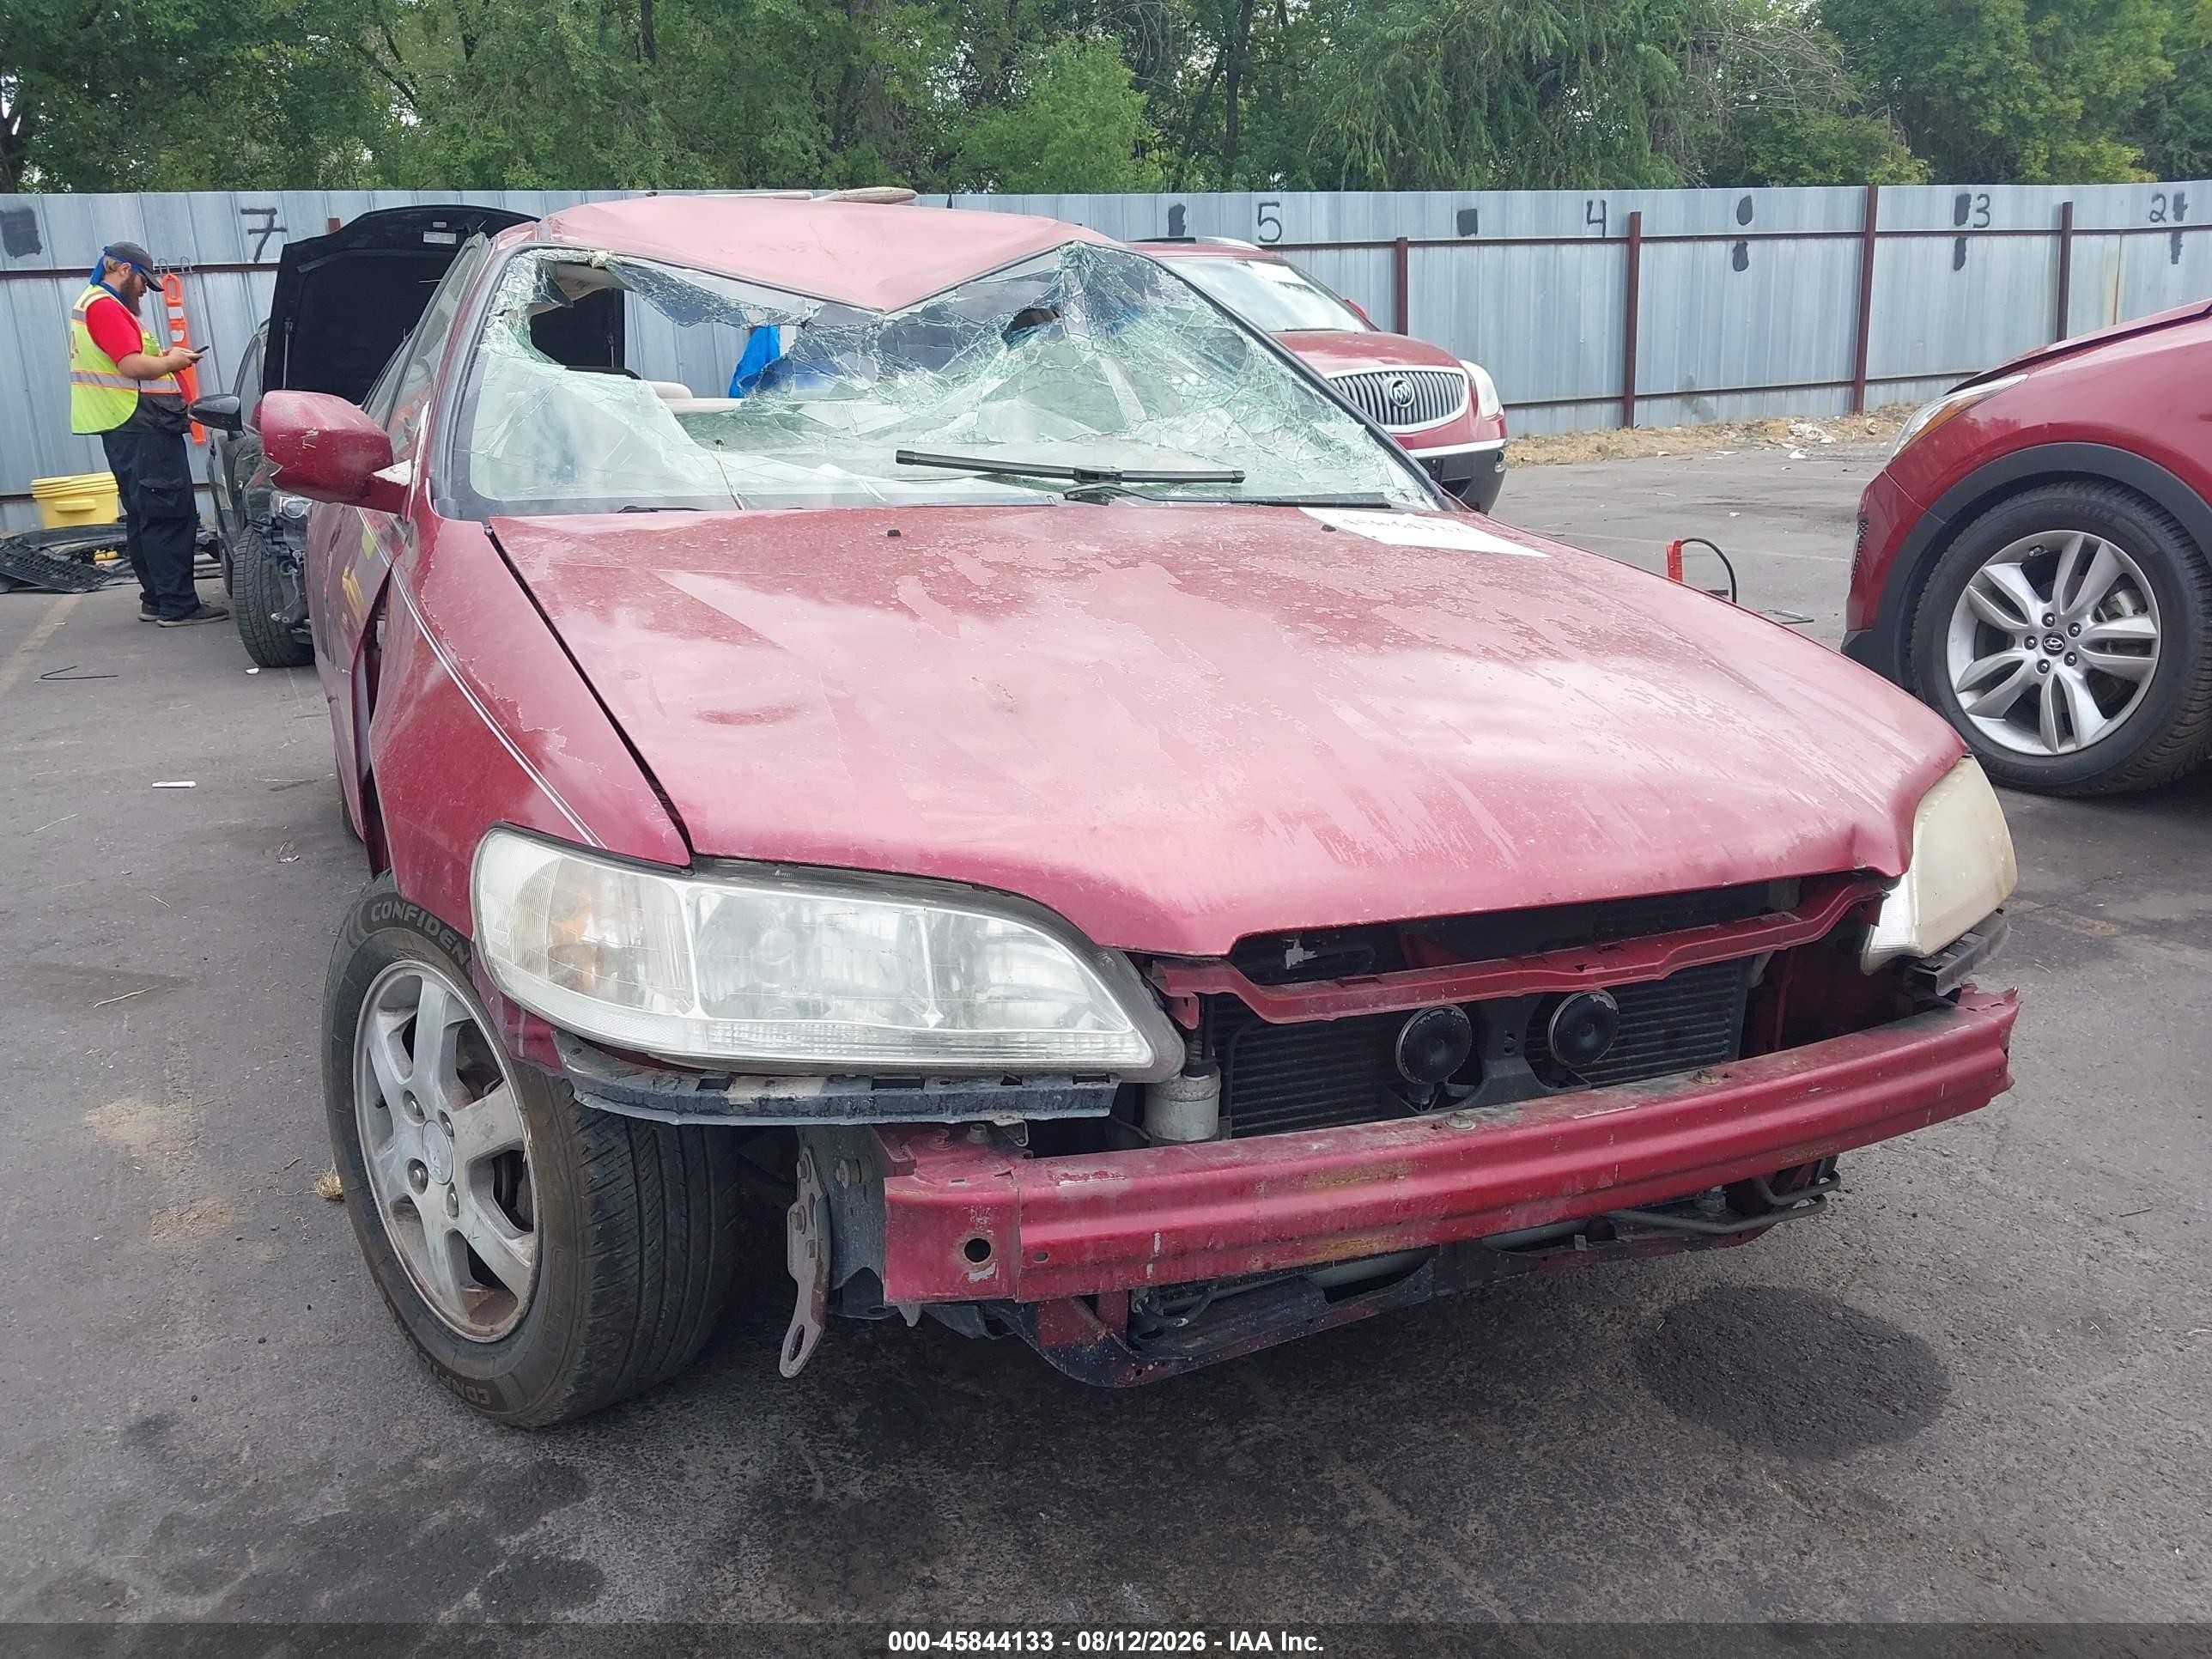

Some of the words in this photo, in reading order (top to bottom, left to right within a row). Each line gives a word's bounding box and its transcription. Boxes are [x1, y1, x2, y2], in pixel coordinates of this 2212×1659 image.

[1258, 201, 1282, 242] 5
[1587, 199, 1607, 237] 4
[1973, 193, 1990, 228] 3
[2149, 193, 2166, 223] 2
[240, 208, 287, 263] 7
